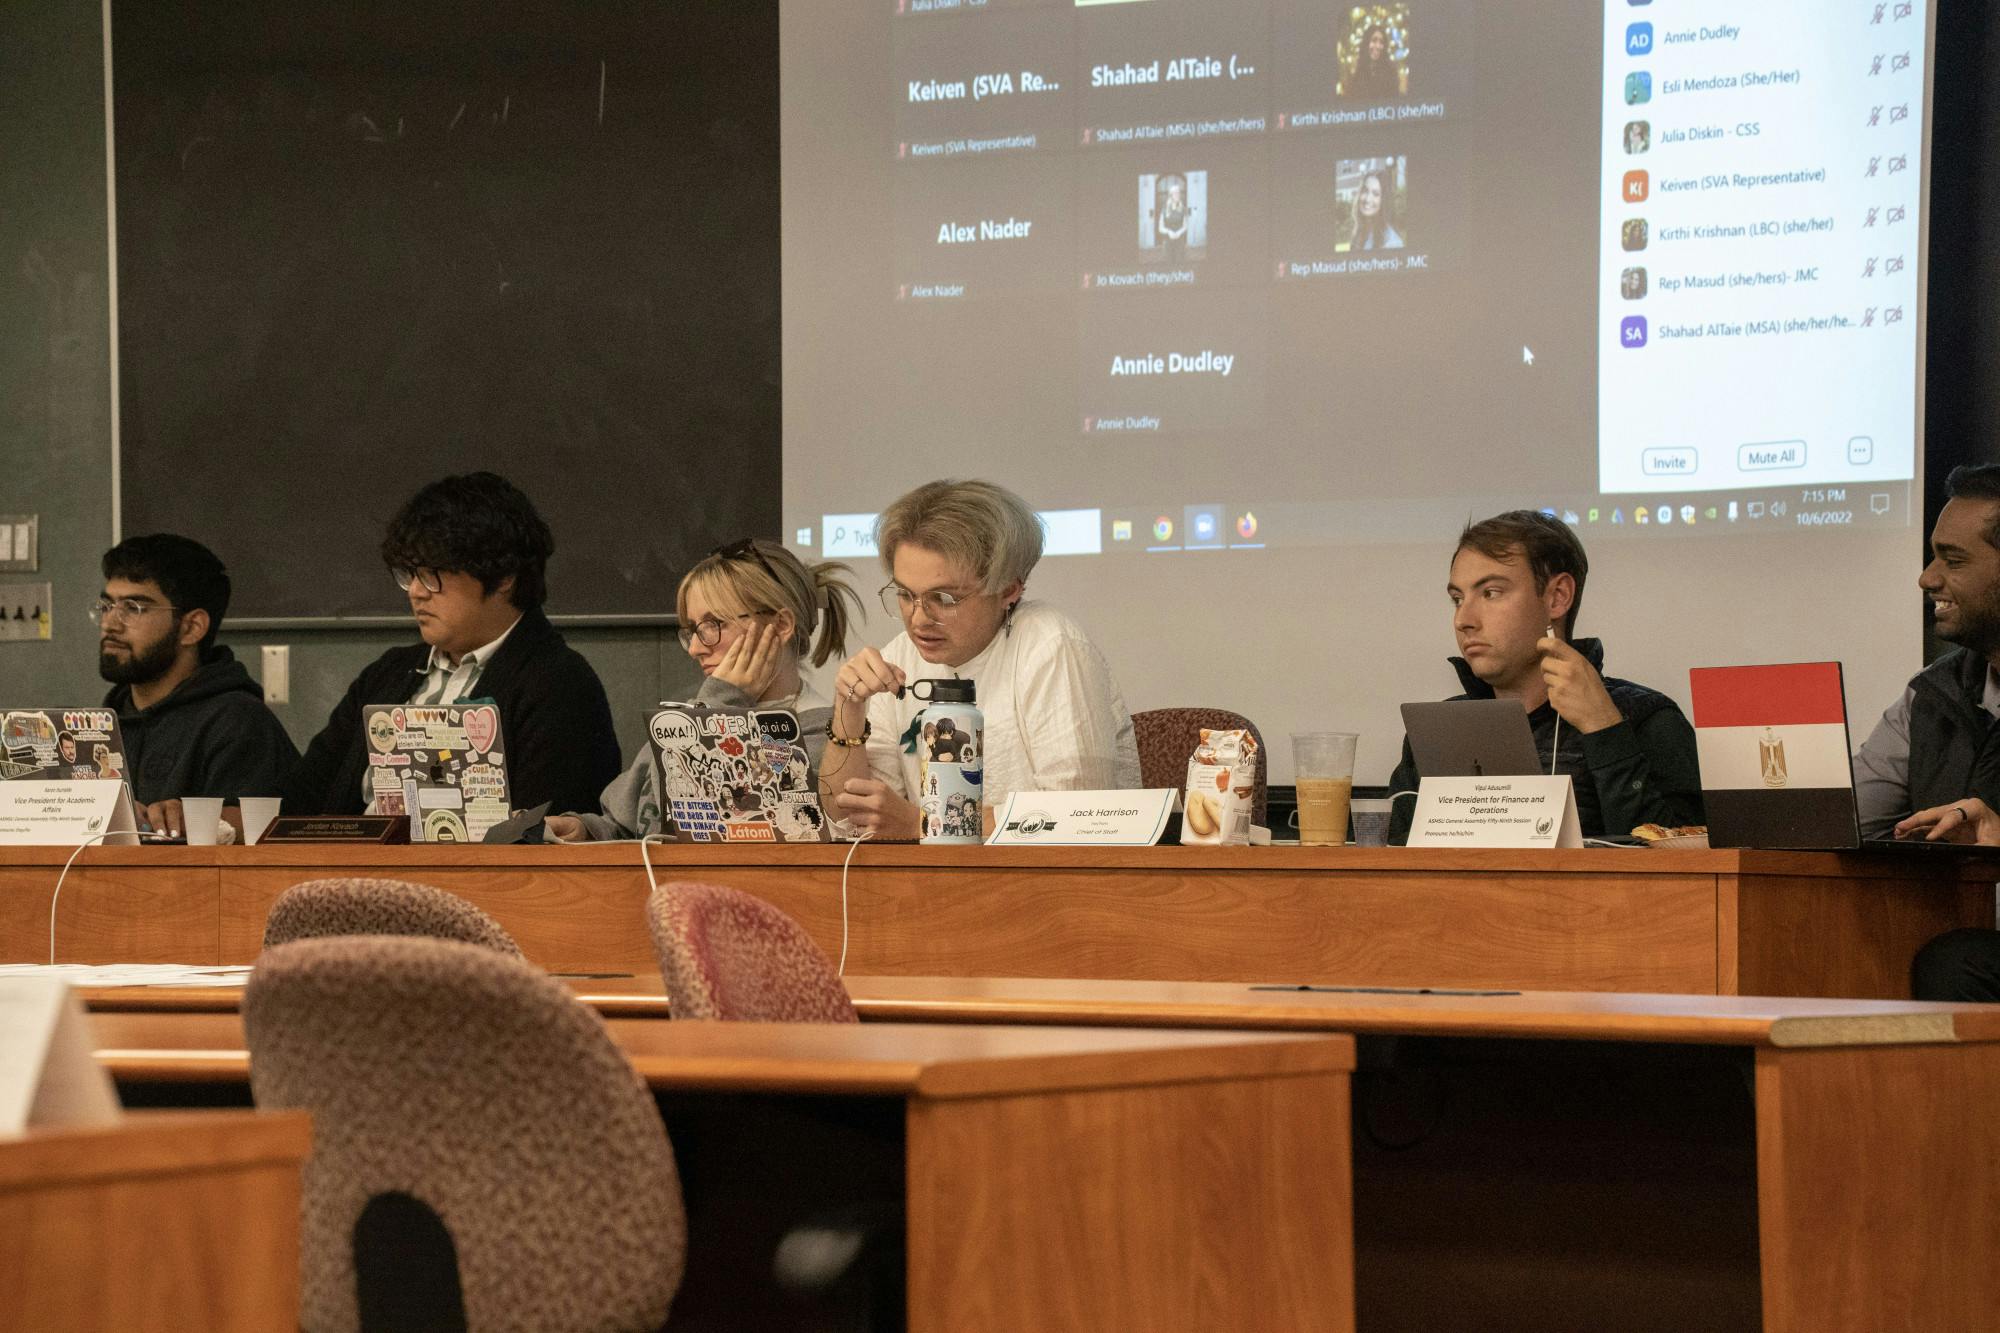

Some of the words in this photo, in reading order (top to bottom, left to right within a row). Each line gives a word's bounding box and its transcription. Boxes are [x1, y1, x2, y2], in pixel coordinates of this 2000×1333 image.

[1630, 33, 1649, 49] AD
[1664, 29, 1697, 44] Annie
[1700, 25, 1740, 42] Dudley
[1091, 61, 1159, 87] Shahad
[1166, 56, 1222, 81] AlTaie
[909, 80, 965, 102] Keiven
[973, 73, 1013, 100] (SVA
[1021, 72, 1059, 92] Re...
[1663, 79, 1681, 94] Esli
[1684, 75, 1737, 92] Mendoza
[1740, 69, 1800, 88] (She/Her)
[1292, 112, 1319, 127] Kirthi
[1321, 109, 1366, 124] Krishnan
[1368, 106, 1395, 122] (LBC)
[1398, 103, 1443, 119] (she/her)
[1097, 128, 1132, 142] Shahad
[1135, 125, 1163, 139] AlTaie
[1166, 123, 1195, 138] (MSA)
[1197, 117, 1265, 136] (she/her/hers)
[1661, 129, 1686, 143] Julia
[1689, 125, 1724, 140] Diskin
[1736, 122, 1760, 137] CSS
[912, 143, 944, 156] Keiven
[945, 140, 966, 155] (SVA
[968, 134, 1036, 152] Representative)
[1660, 177, 1697, 192] Keiven
[1701, 174, 1729, 191] (SVA
[1733, 168, 1826, 188] Representative)
[937, 222, 976, 243] Alex
[980, 218, 1032, 240] Nader
[1659, 225, 1690, 241] Kirthi
[1694, 221, 1746, 239] Krishnan
[1749, 220, 1780, 237] (LBC)
[1783, 216, 1834, 236] (she/her)
[1291, 263, 1310, 277] Rep
[1312, 259, 1346, 274] Masud
[1406, 255, 1428, 268] JMC
[1096, 275, 1107, 287] Jo
[1109, 272, 1144, 286] Kovach
[1146, 269, 1194, 286] (they/she)
[1659, 276, 1681, 292] Rep
[1685, 273, 1725, 289] Masud
[1794, 267, 1819, 283] JMC
[912, 286, 934, 298] Alex
[935, 284, 964, 297] Nader
[1625, 326, 1643, 342] SA
[1659, 322, 1703, 340] Shahad
[1707, 321, 1742, 338] AlTaie
[1745, 319, 1781, 335] (MSA)
[1111, 354, 1164, 376] Annie
[1169, 352, 1234, 375] Dudley
[1097, 417, 1124, 431] Annie
[1126, 416, 1159, 431] Dudley
[1653, 455, 1686, 470] Invite
[1749, 450, 1777, 465] Mute
[1780, 447, 1795, 463] All
[1802, 489, 1825, 502] 7:15
[1828, 488, 1846, 502] PM
[1797, 510, 1852, 526] 10/6/2022
[655, 725, 695, 740] BAKA!!
[698, 715, 749, 737] LOVER
[672, 800, 685, 810] HEY
[1439, 796, 1453, 804] Vice
[1455, 796, 1488, 804] President
[1501, 796, 1529, 804] Finance
[1531, 795, 1545, 803] and
[1070, 808, 1094, 818] Jack
[1096, 807, 1139, 817] Harrison
[1469, 806, 1508, 815] Operations
[727, 823, 771, 839] Látom
